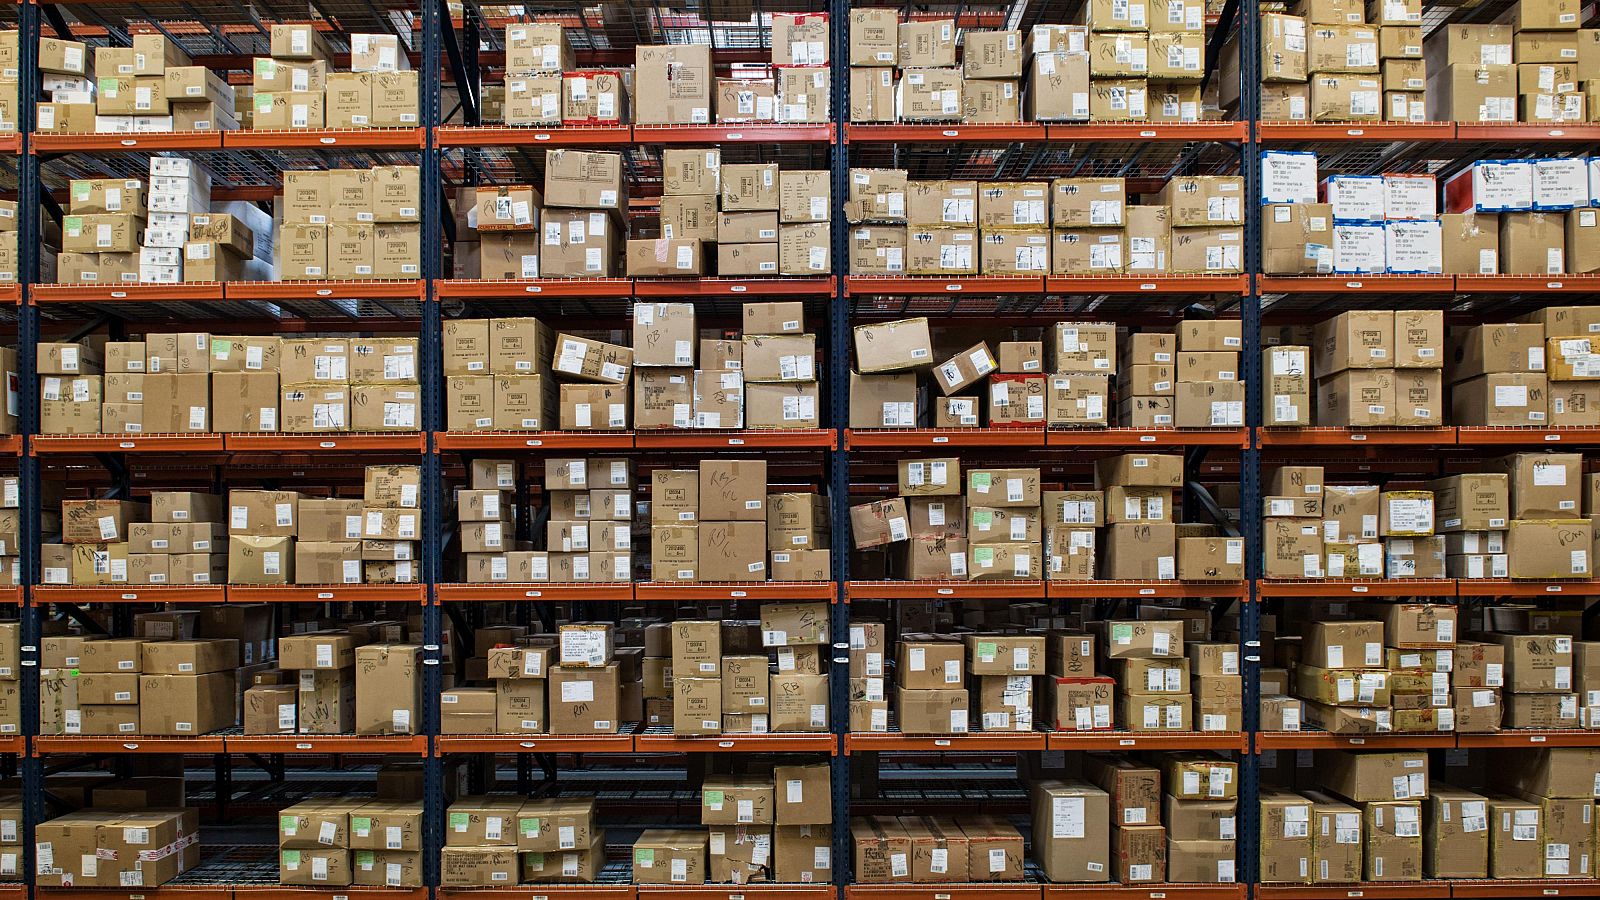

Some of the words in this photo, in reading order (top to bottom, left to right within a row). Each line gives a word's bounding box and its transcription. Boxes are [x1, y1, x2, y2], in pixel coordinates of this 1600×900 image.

[596, 75, 611, 92] RB
[1050, 76, 1061, 90] RB
[646, 330, 660, 348] RB
[1027, 381, 1041, 394] RB
[1134, 527, 1150, 540] RM
[781, 682, 799, 695] RB
[1095, 685, 1108, 698] RB
[573, 703, 589, 718] RM
